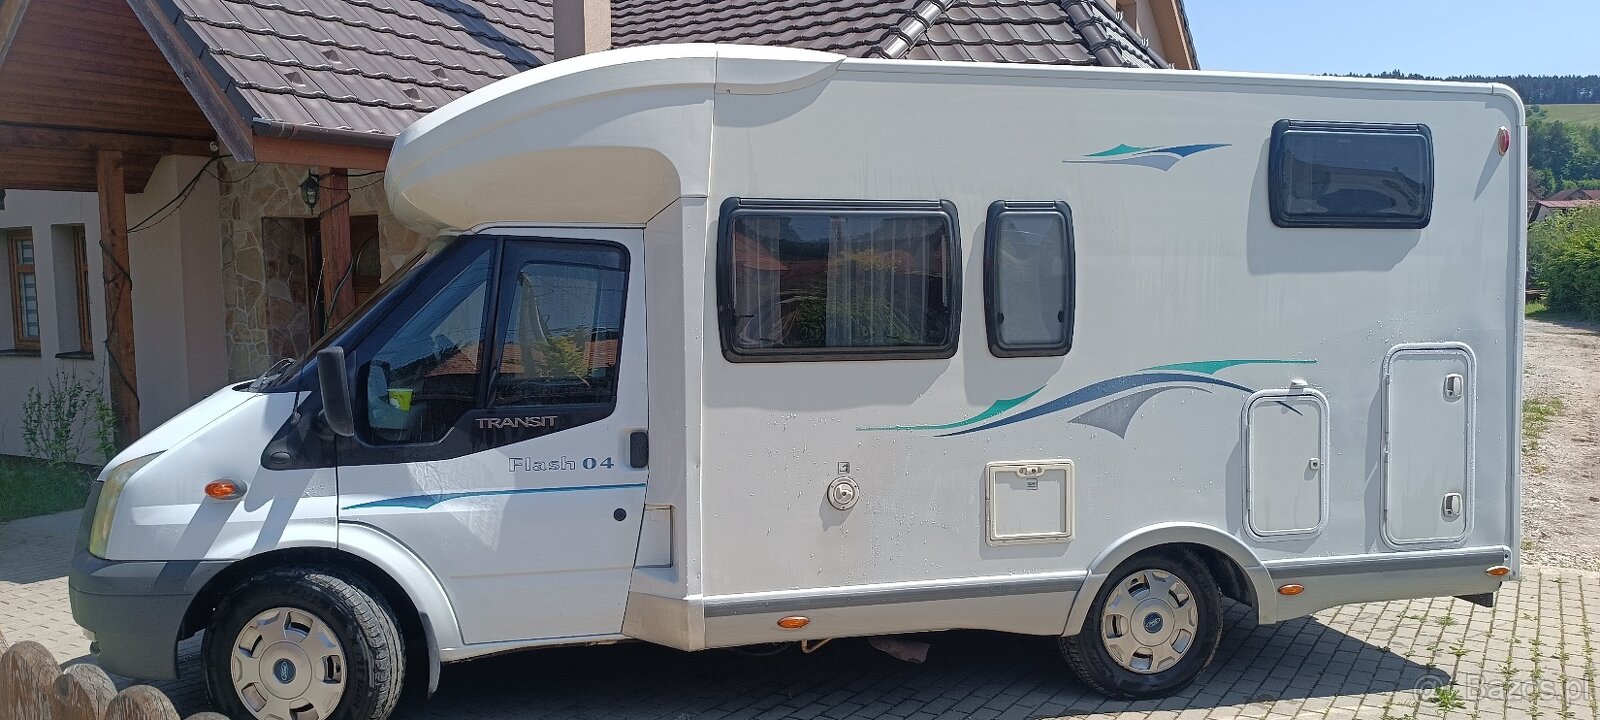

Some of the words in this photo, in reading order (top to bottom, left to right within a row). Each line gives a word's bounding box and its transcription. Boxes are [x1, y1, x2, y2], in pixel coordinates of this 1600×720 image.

[475, 415, 558, 429] TRANSIT
[508, 456, 576, 472] Flash
[582, 457, 615, 470] 04
